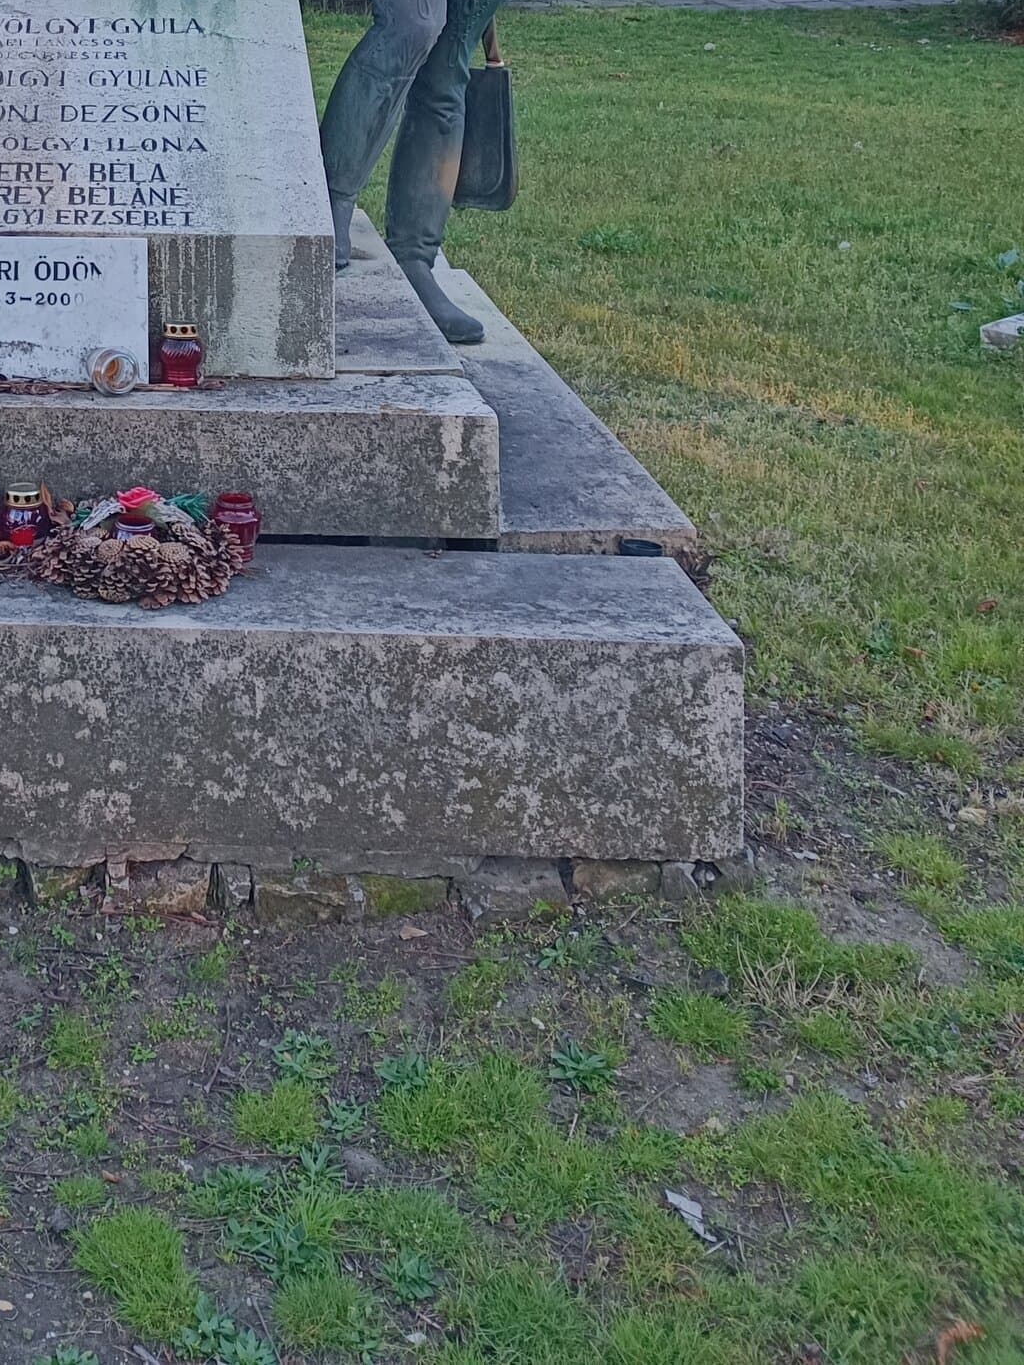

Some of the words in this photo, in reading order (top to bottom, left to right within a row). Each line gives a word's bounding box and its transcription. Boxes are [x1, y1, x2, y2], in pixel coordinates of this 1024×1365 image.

[110, 17, 204, 35] GYULA
[107, 137, 208, 152] ILONA
[89, 159, 168, 183] BÉLA
[68, 182, 188, 207] BÉLÁNÉ
[55, 205, 195, 227] ERZSÉBET
[34, 255, 103, 282] ÖDÖN
